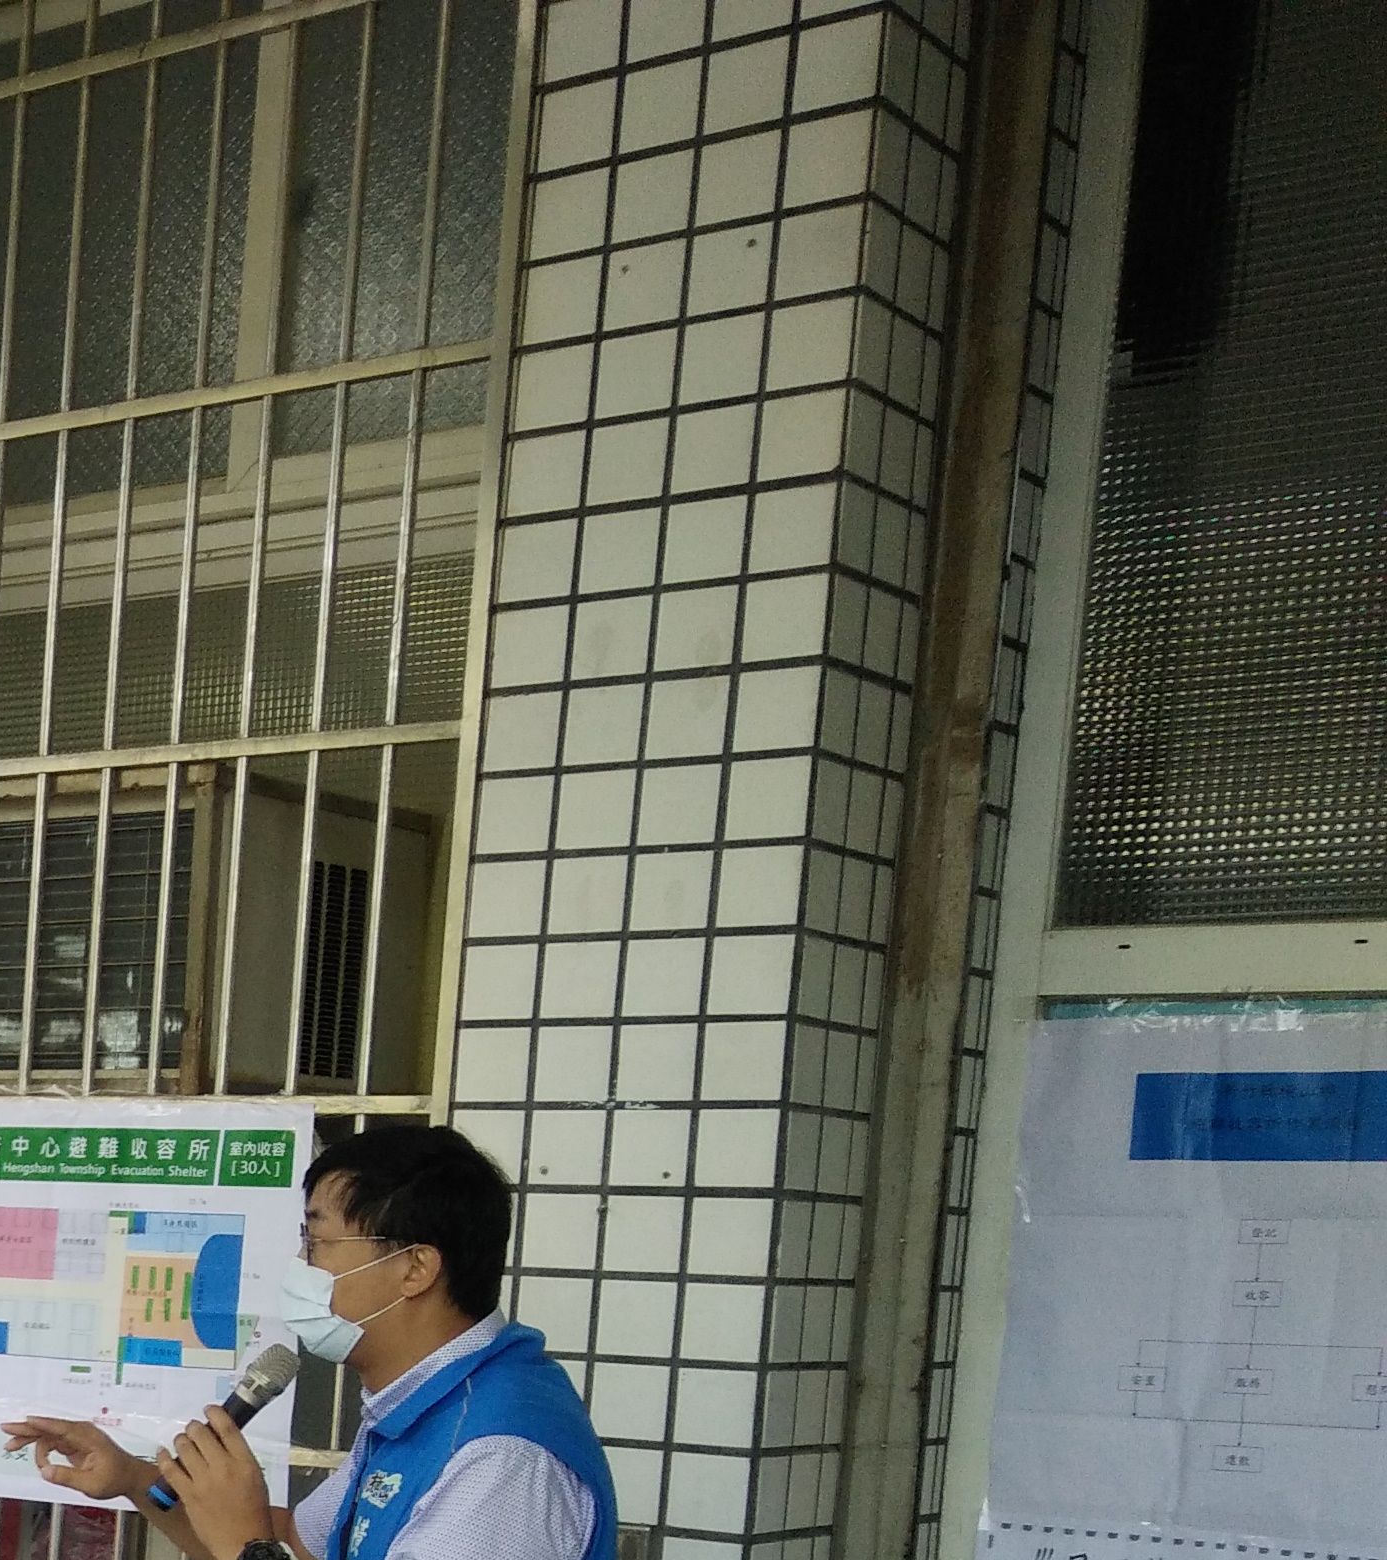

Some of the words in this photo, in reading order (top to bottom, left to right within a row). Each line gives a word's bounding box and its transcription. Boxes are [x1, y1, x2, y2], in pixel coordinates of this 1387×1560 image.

[229, 1141, 286, 1157] 室內收容
[3, 1162, 55, 1176] Hengshan
[60, 1163, 106, 1177] Township
[111, 1163, 164, 1177] Evacuation
[168, 1165, 209, 1178] Shelter
